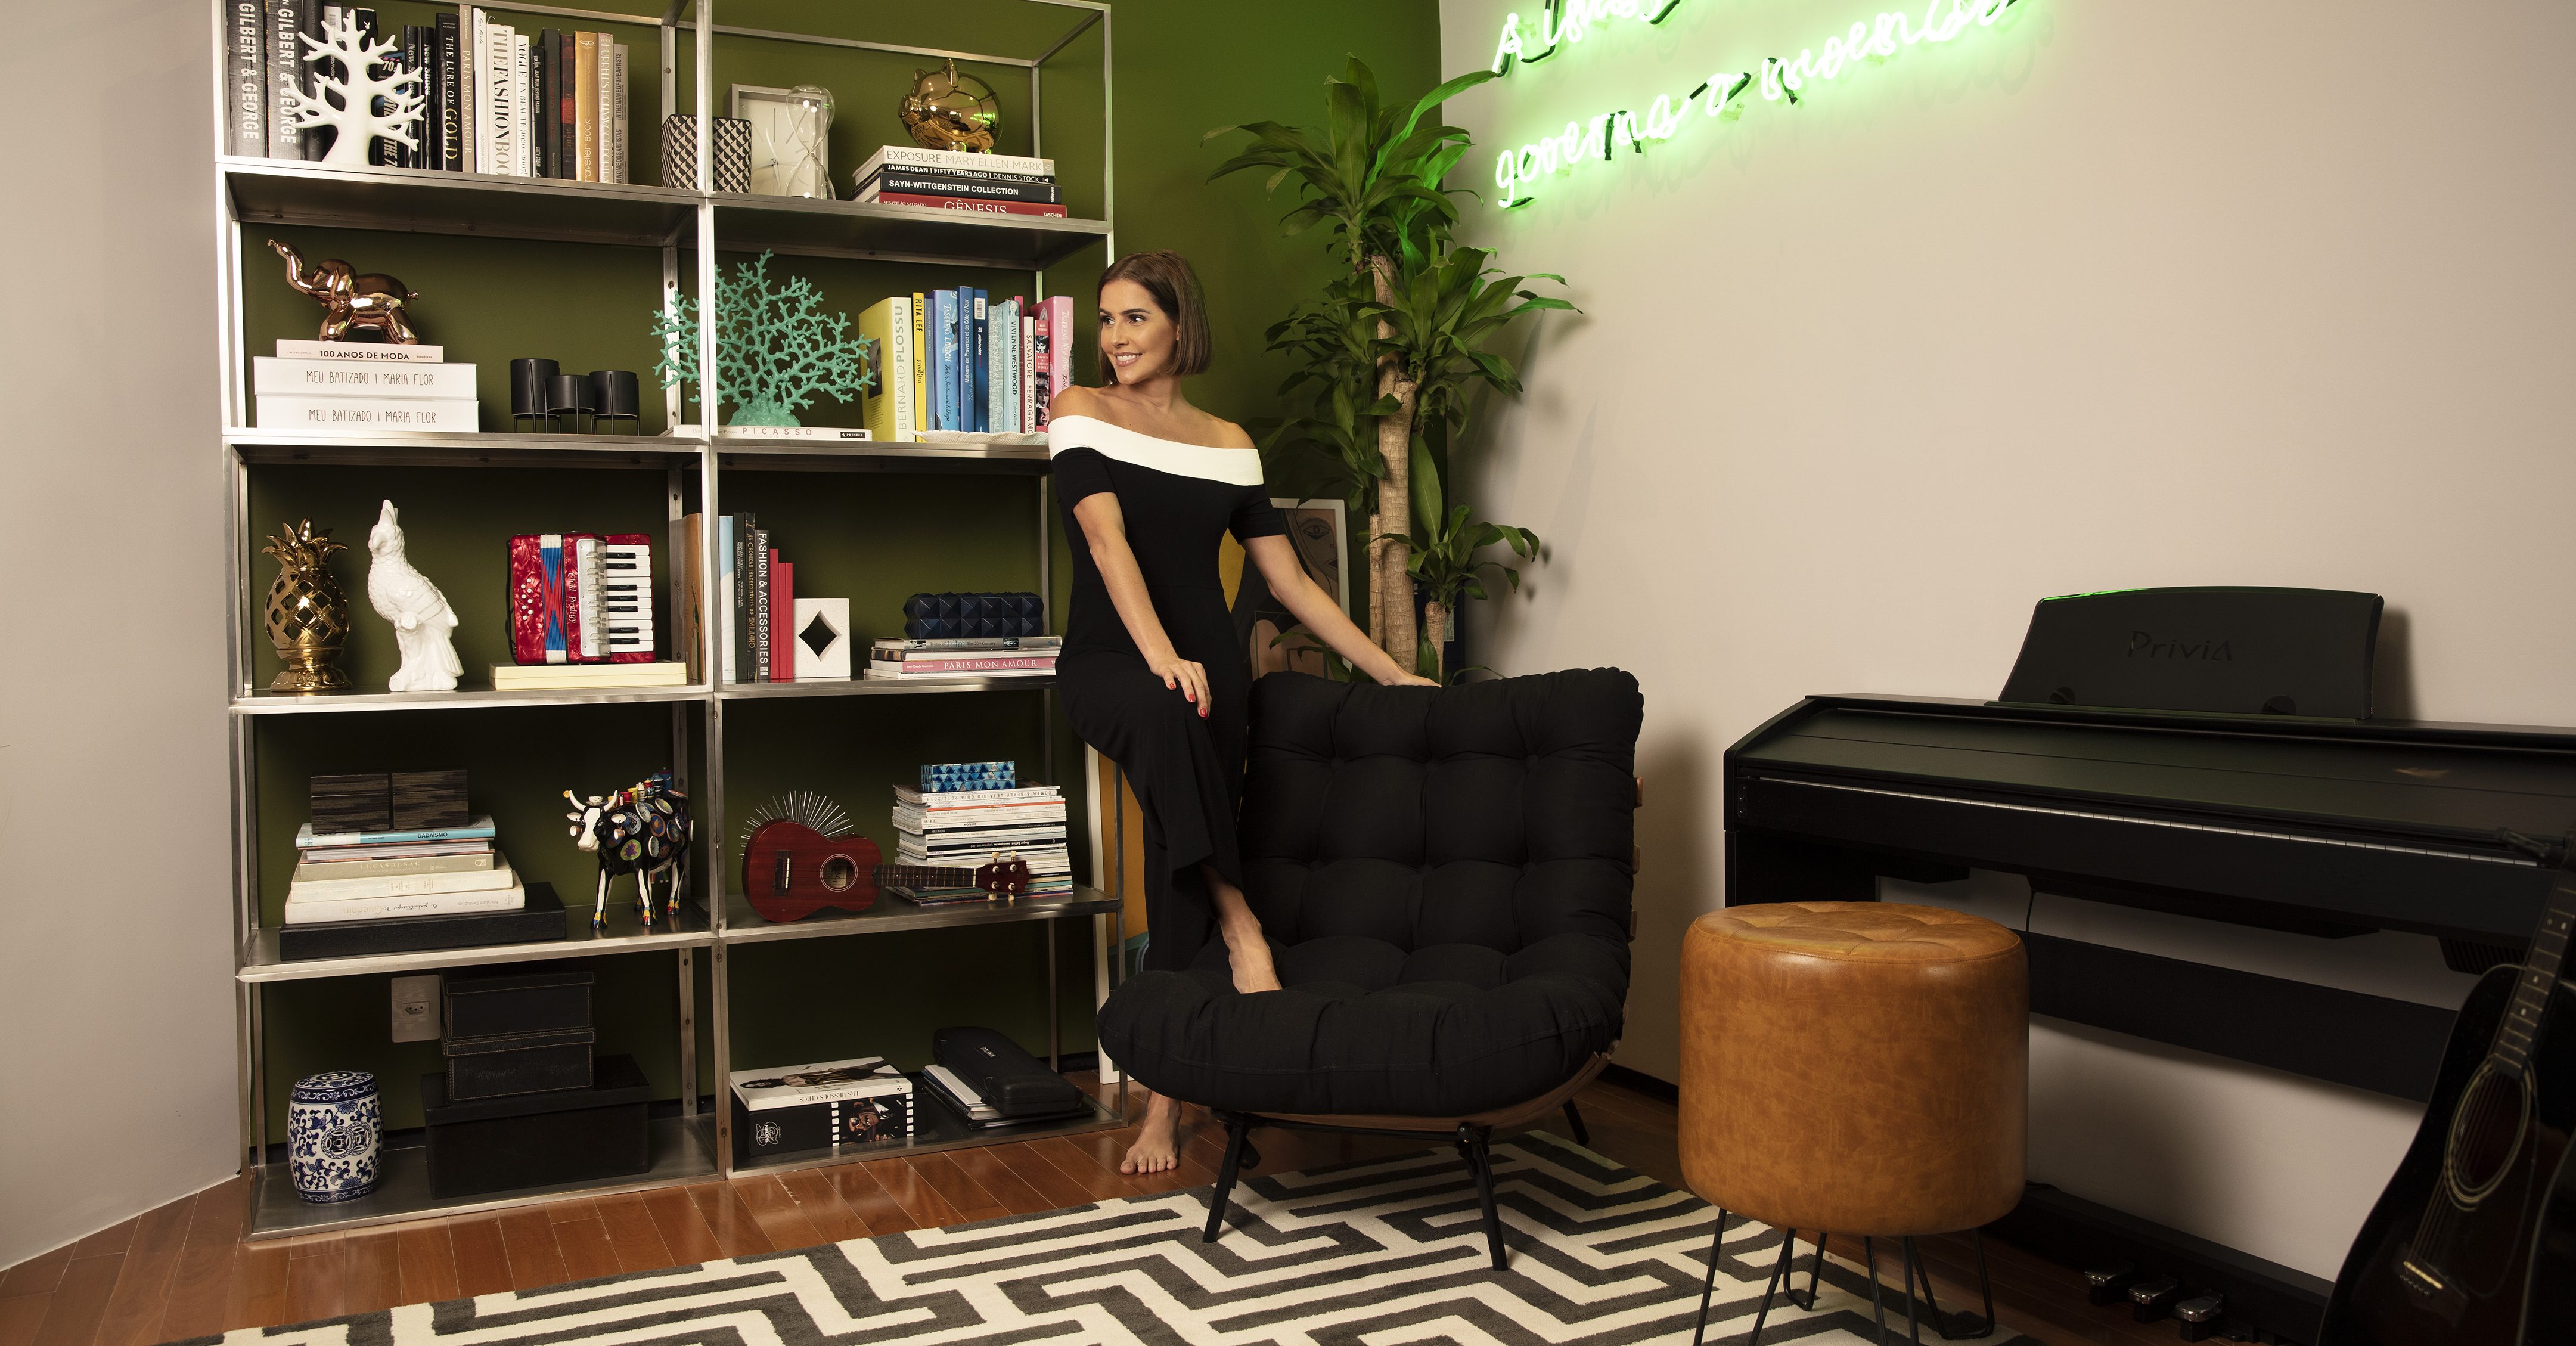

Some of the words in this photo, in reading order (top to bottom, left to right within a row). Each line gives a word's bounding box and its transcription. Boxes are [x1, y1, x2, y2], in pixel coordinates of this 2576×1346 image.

[238, 3, 257, 63] GILBERT
[278, 8, 295, 68] GILBERT
[1491, 13, 1523, 73] A
[408, 42, 417, 63] New
[424, 44, 432, 64] New
[445, 36, 454, 58] THE
[462, 49, 471, 80] PARIS
[517, 44, 527, 77] VOGUE
[601, 44, 610, 88] HURRELL'S
[240, 67, 257, 77] &
[424, 67, 433, 95] Shoes
[446, 60, 455, 87] LURE
[446, 90, 455, 105] OF
[463, 85, 472, 112] MON
[519, 82, 527, 94] EN
[241, 83, 259, 139] GEORGE
[279, 88, 296, 144] GEORGE
[519, 96, 529, 128] BEAUTÉ
[601, 90, 610, 147] HOLLYWOOD
[444, 108, 458, 159] GOLD
[464, 114, 473, 154] AMOUR
[383, 139, 398, 157] THE
[887, 150, 942, 164] EXPOSURE
[945, 154, 976, 167] MARY
[978, 157, 1010, 169] ELLEN
[1011, 160, 1042, 172] MARK
[887, 164, 910, 172] JAMES
[910, 166, 929, 174] DEAN
[992, 172, 1018, 181] DENNIS
[888, 179, 969, 193] SAYN-WITTGENSTEIN
[970, 185, 1019, 196] COLLECTION
[944, 199, 1007, 214] GÊNESIS
[915, 299, 924, 317] RITA
[895, 305, 904, 362] PLOSSU
[319, 349, 336, 358] 100
[336, 351, 364, 359] ANOS
[366, 351, 378, 359] DE
[381, 352, 410, 361] MODA
[944, 336, 952, 362] LONDON
[1062, 342, 1070, 355] NEW
[1062, 356, 1070, 372] YORK
[306, 371, 324, 384] MEU
[330, 371, 370, 385] BATIZADO
[383, 373, 409, 386] MARIA
[414, 374, 434, 386] FLOR
[898, 365, 907, 430] BERNARD
[309, 409, 327, 423] MEU
[332, 410, 371, 423] BATIZADO
[386, 411, 411, 424] MARIA
[416, 411, 437, 424] FLOR
[742, 427, 813, 436] PICASSO
[758, 532, 768, 578] FASHION
[567, 572, 577, 592] Child
[759, 580, 768, 588] &
[567, 596, 578, 624] Prodigy
[759, 590, 768, 664] ACCESSORIES
[1001, 659, 1038, 668] AMOUR
[343, 905, 383, 916] Guerlain
[799, 1094, 818, 1103] CHICS
[819, 1091, 846, 1100] DESSOUS
